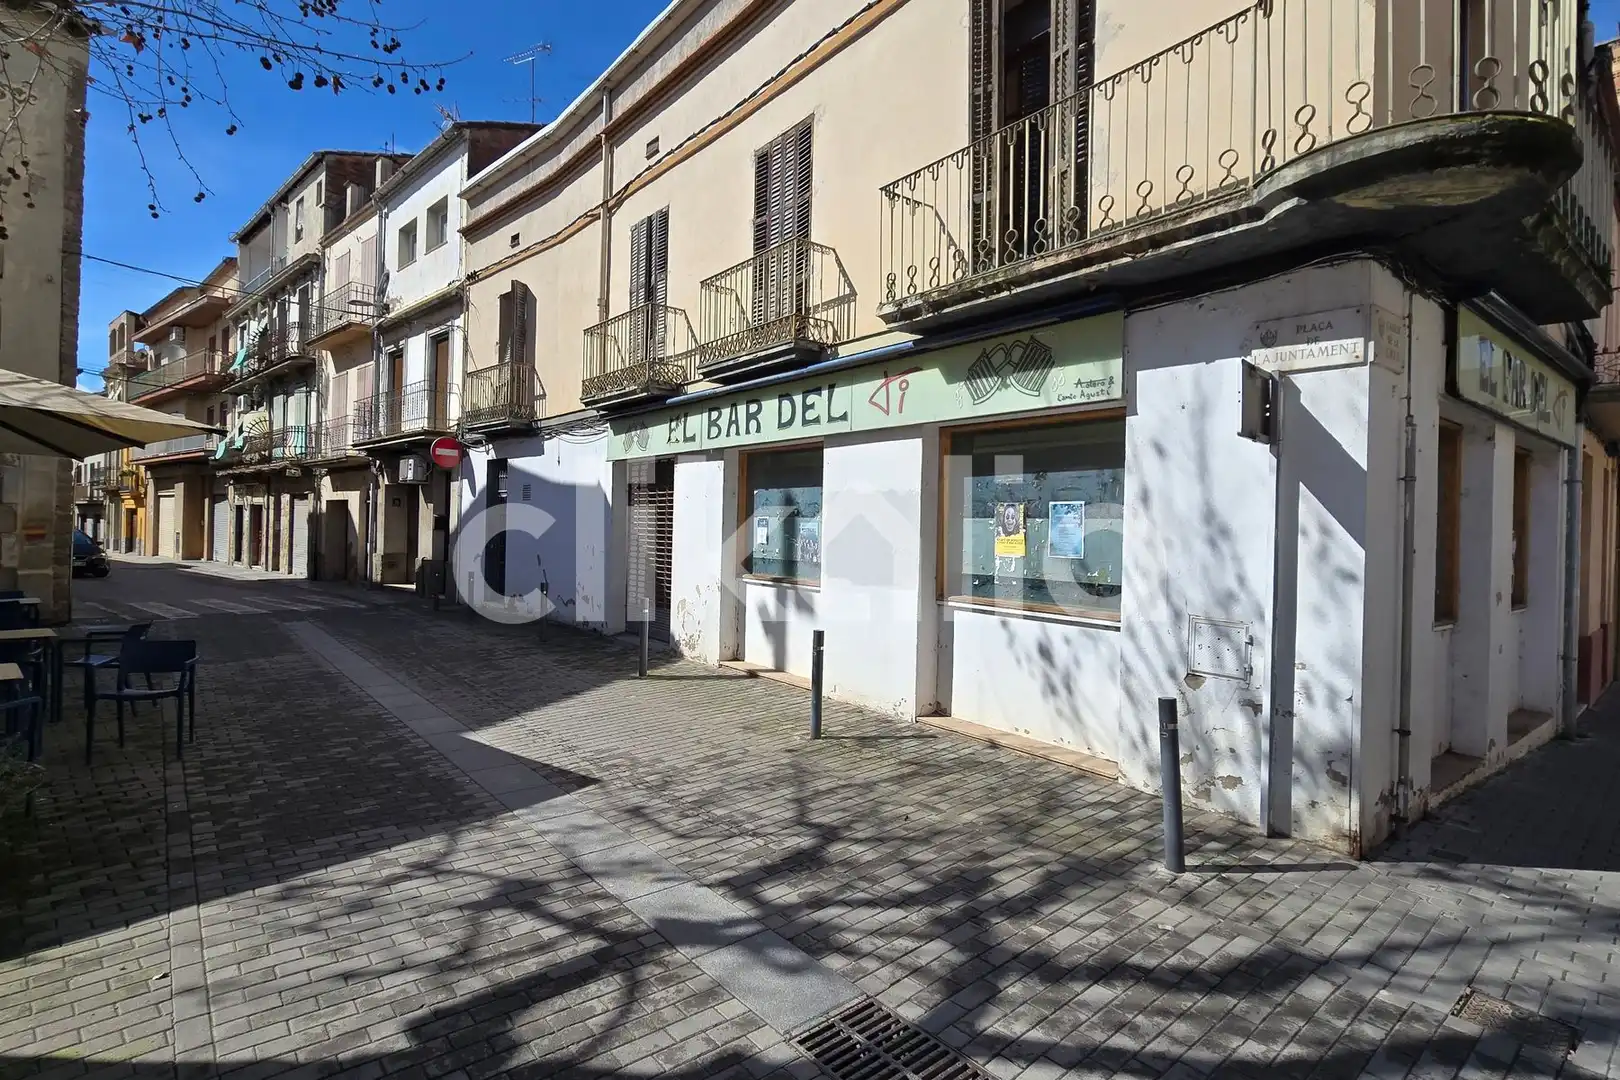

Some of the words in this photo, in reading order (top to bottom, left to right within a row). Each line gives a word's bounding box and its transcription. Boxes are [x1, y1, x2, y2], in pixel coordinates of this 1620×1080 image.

[1305, 336, 1320, 345] DE
[707, 399, 762, 439] BAR
[777, 383, 848, 429] DEL
